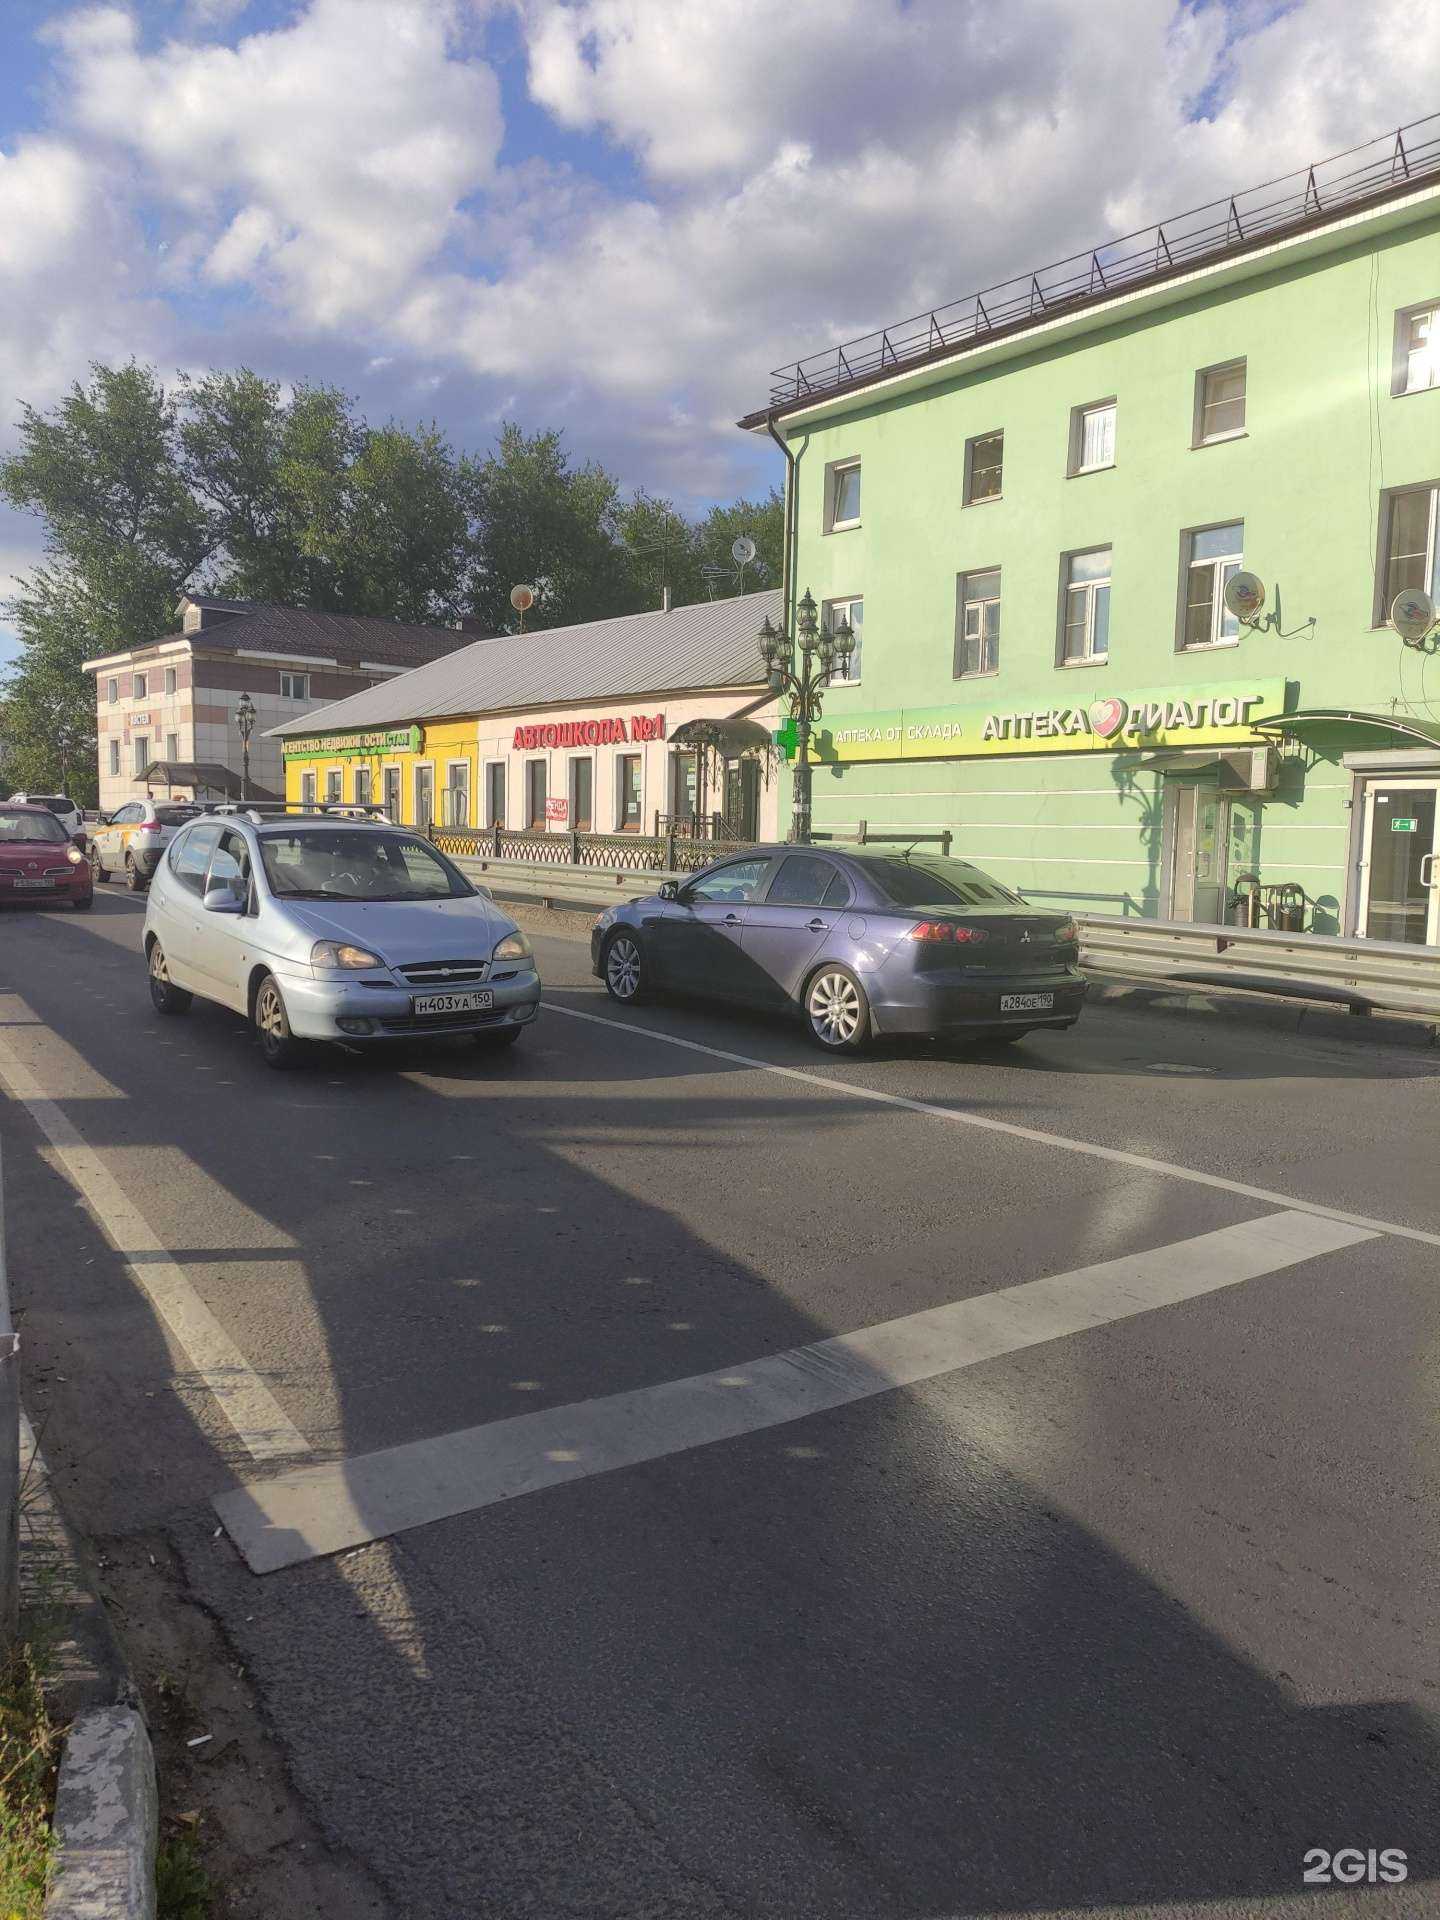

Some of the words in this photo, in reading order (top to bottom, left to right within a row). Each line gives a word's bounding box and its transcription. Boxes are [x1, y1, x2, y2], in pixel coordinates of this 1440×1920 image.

[512, 718, 628, 749] АВТОШКОЛА
[631, 713, 664, 741] №1
[983, 707, 1092, 741] АПТЕКА
[1122, 695, 1263, 738] ДИАЛОГ
[281, 738, 321, 755] АГЕНТСТВО
[836, 727, 882, 743] АПТЕКА
[885, 726, 903, 741] ОТ
[907, 723, 962, 740] СКЛАДА
